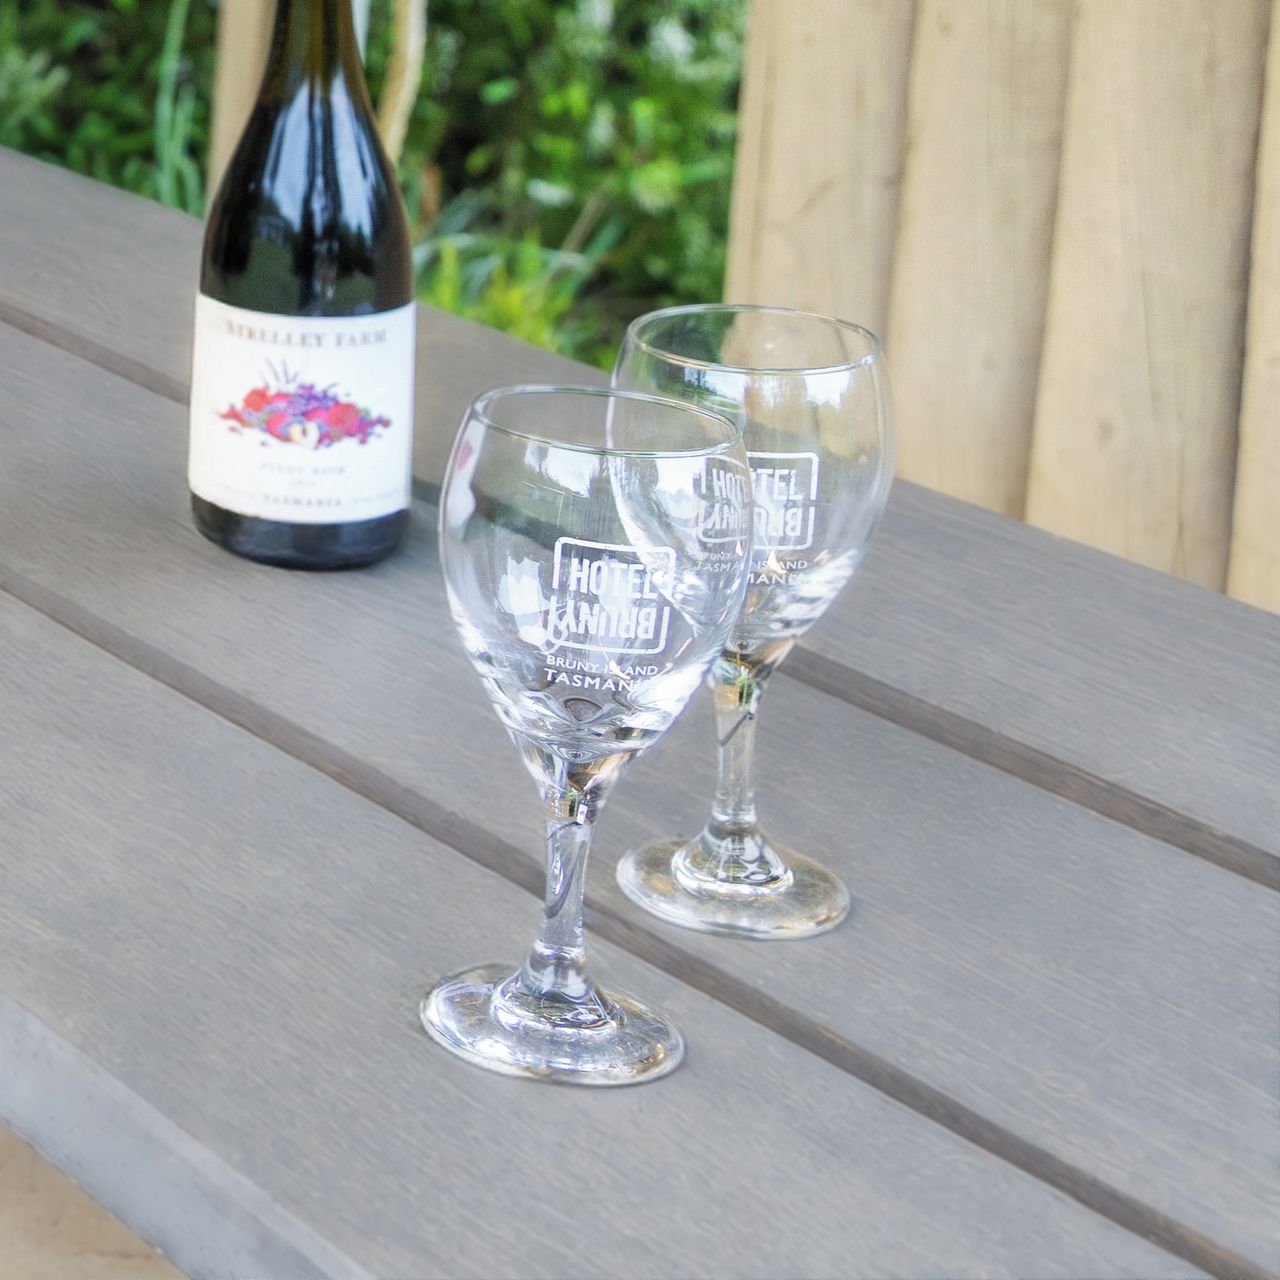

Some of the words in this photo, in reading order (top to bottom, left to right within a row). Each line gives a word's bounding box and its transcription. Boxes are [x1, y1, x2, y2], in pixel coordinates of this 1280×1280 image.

[335, 329, 388, 348] FARM
[757, 560, 809, 571] ISAND
[568, 557, 658, 600] HOTEL
[560, 599, 657, 640] BRUNY
[546, 654, 600, 674] BRUNY
[604, 663, 659, 676] IAND
[543, 668, 635, 693] TASMAN
